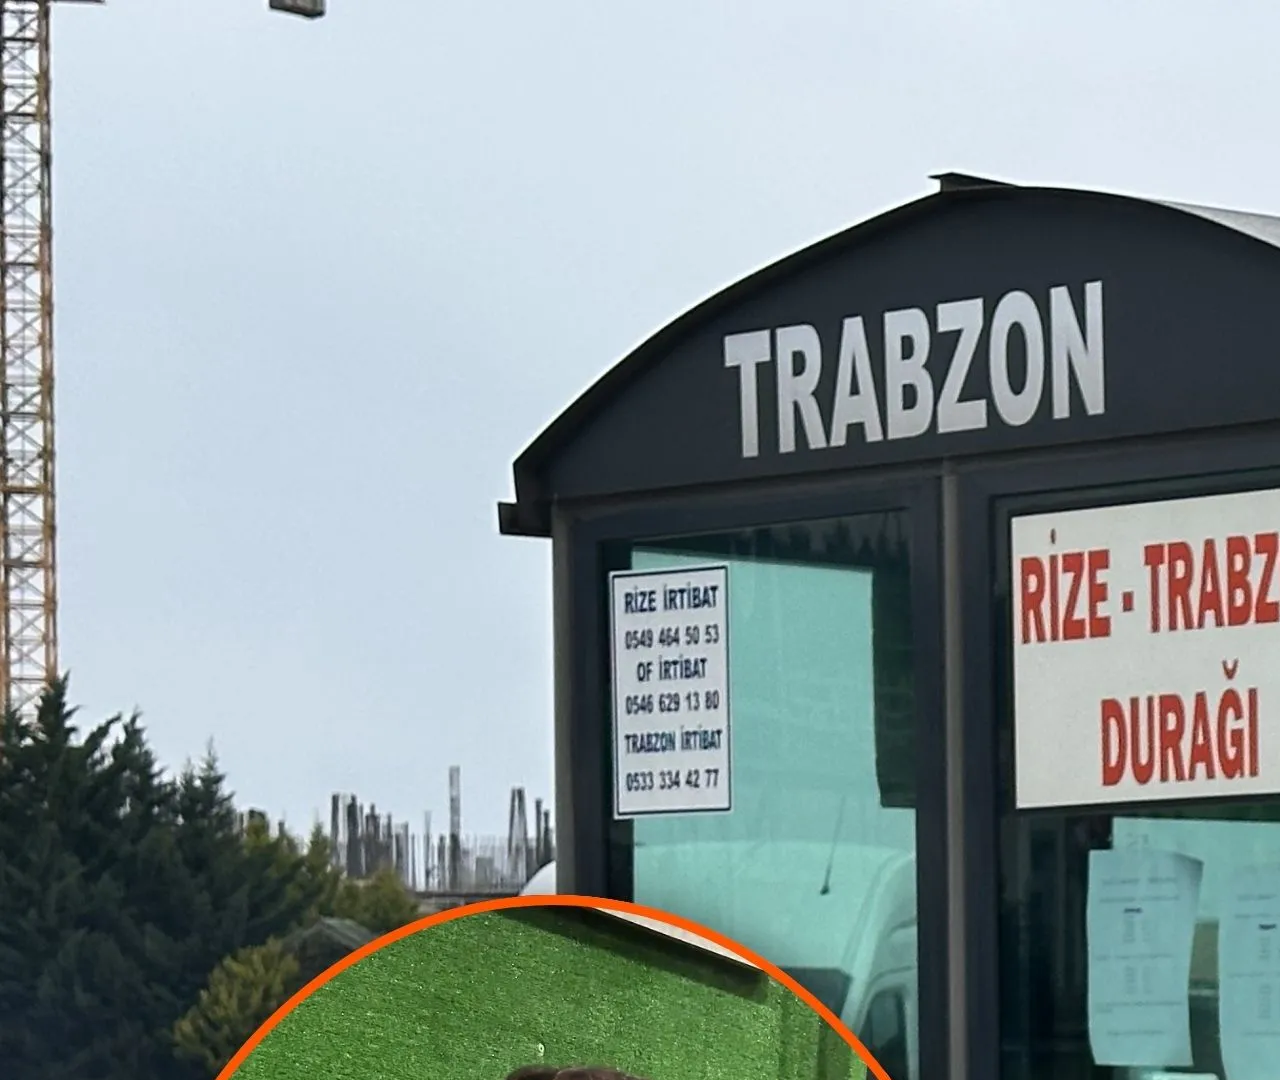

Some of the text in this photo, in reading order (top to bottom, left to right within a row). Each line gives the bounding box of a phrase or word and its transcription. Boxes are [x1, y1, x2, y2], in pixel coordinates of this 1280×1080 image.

[724, 280, 1105, 458] TRABZON
[624, 582, 719, 613] RİZE İRTİBAT
[1020, 528, 1111, 644] RİZE
[625, 624, 719, 650] 0549 464 50 53
[637, 654, 707, 682] OF İRTİBAT
[625, 694, 654, 715] 0546
[659, 692, 680, 713] 629
[686, 691, 700, 711] 13
[1101, 659, 1259, 787] DURAĞI
[624, 724, 723, 754] TRABZON İRTİBAT
[626, 769, 719, 792] 0533 334 42 77
